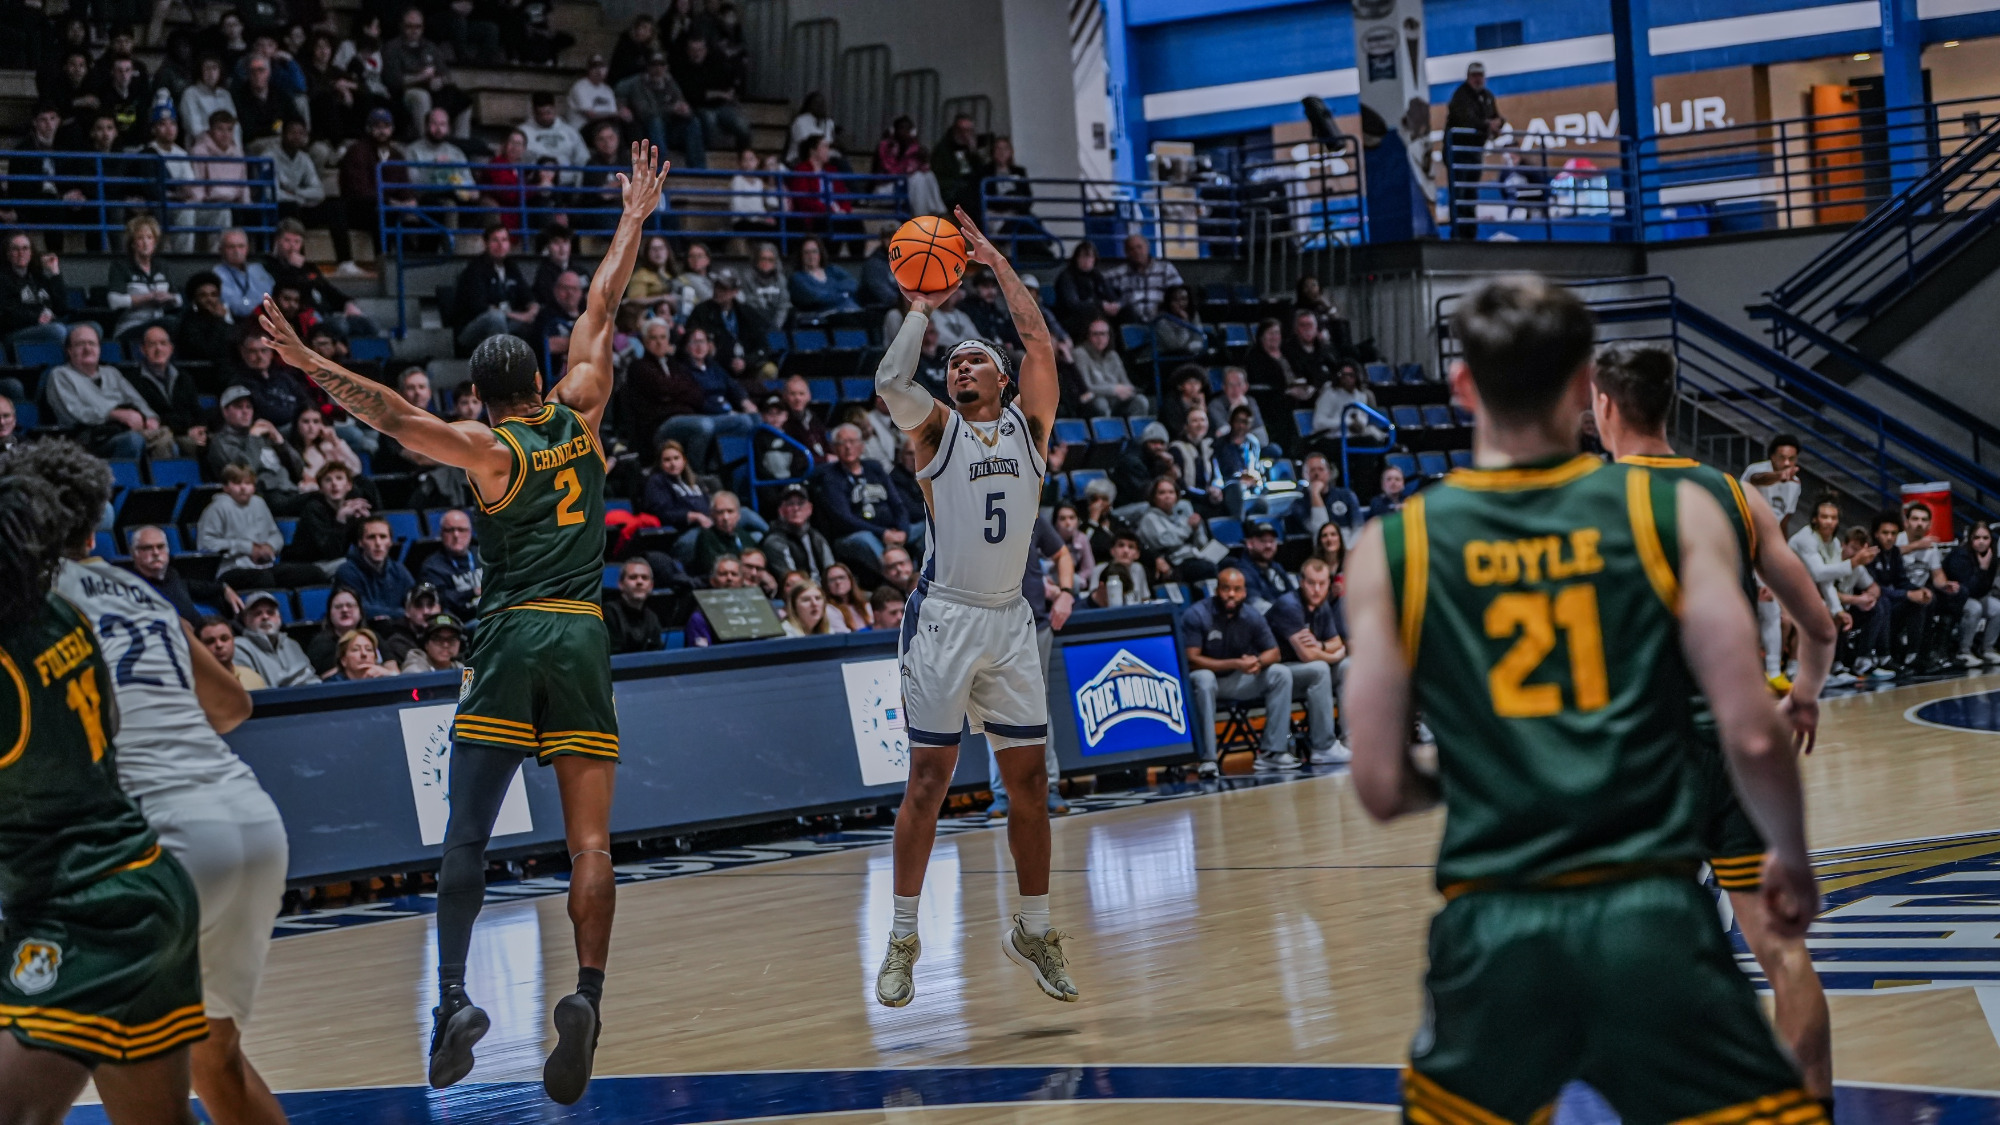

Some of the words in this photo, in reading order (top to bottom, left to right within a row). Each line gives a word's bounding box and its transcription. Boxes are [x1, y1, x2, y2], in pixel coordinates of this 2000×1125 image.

[1519, 96, 1728, 151] ARMUR
[553, 467, 586, 527] 2
[984, 492, 1007, 544] 5
[1463, 527, 1605, 587] COYLE
[99, 613, 190, 690] 21
[1482, 582, 1611, 718] 21
[1081, 680, 1119, 734] THE
[1115, 675, 1181, 722] MOUNT
